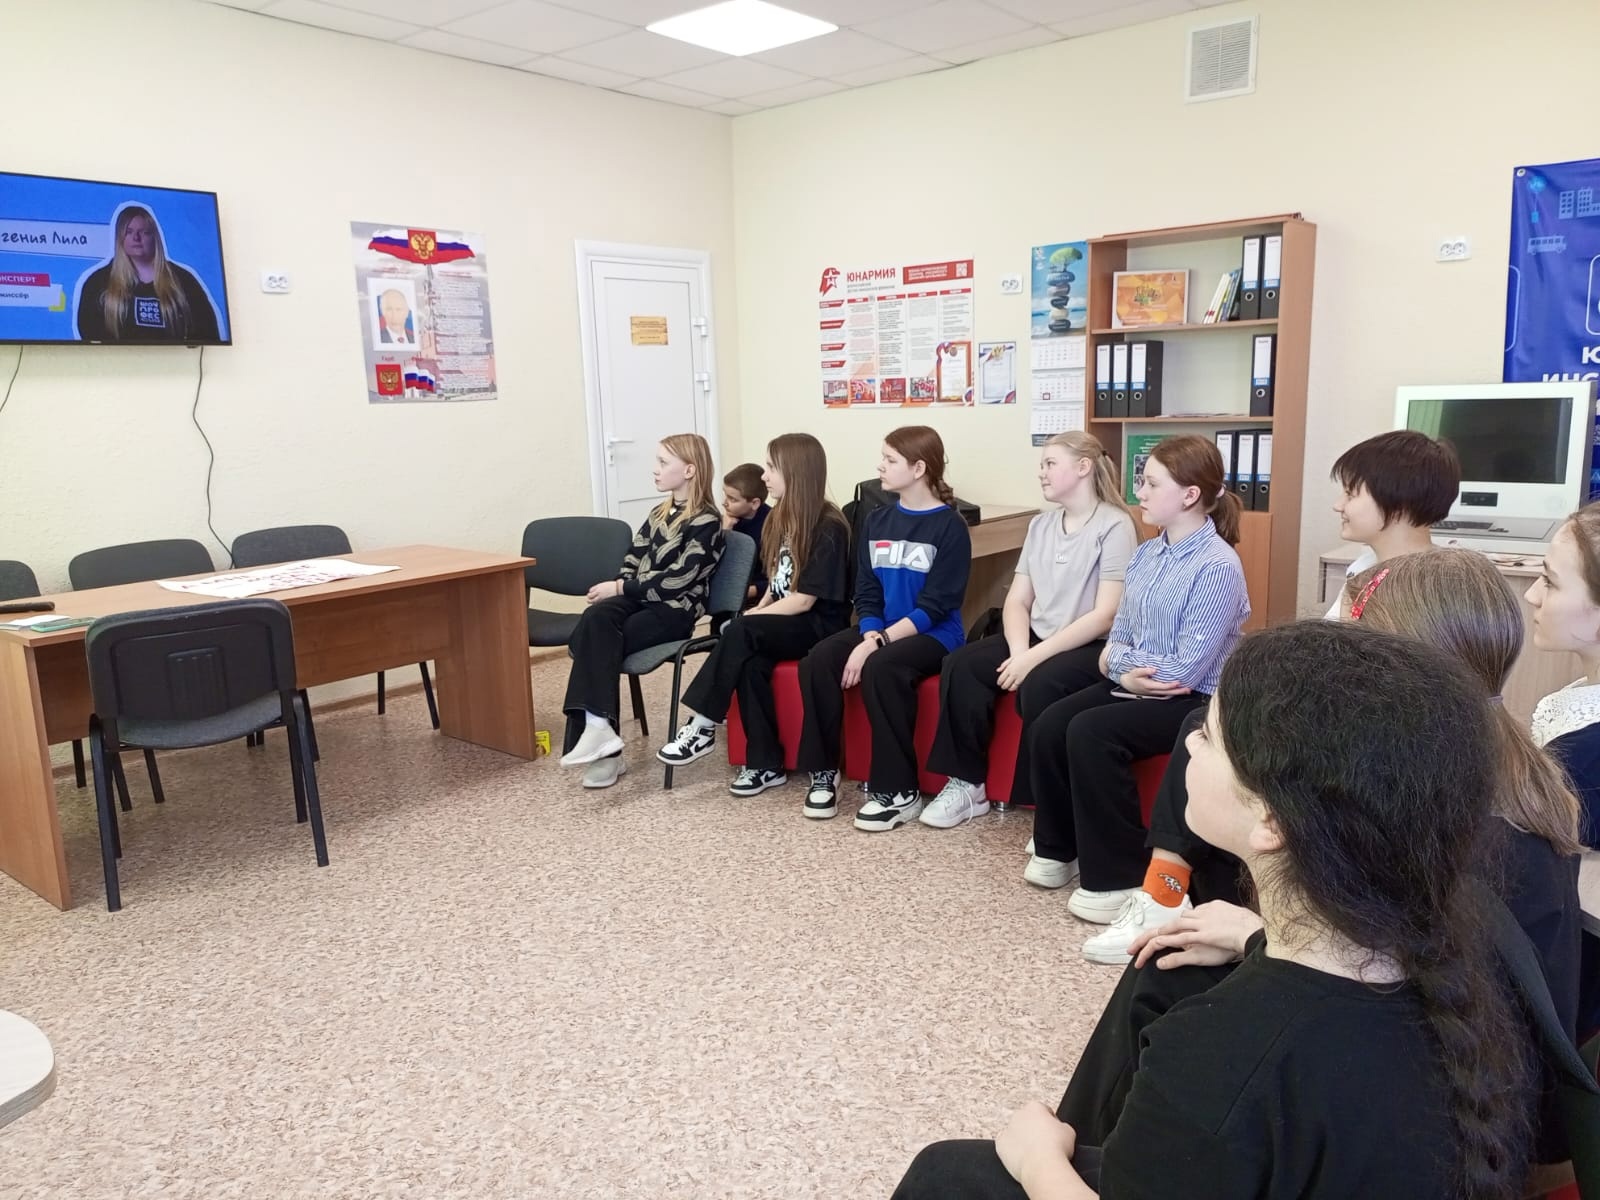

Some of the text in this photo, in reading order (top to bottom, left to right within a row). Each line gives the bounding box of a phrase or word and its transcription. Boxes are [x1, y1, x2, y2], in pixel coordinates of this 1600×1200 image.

[1, 231, 88, 245] гения Лила
[846, 267, 896, 282] ЮНАРМИЯ
[873, 541, 930, 569] FILA
